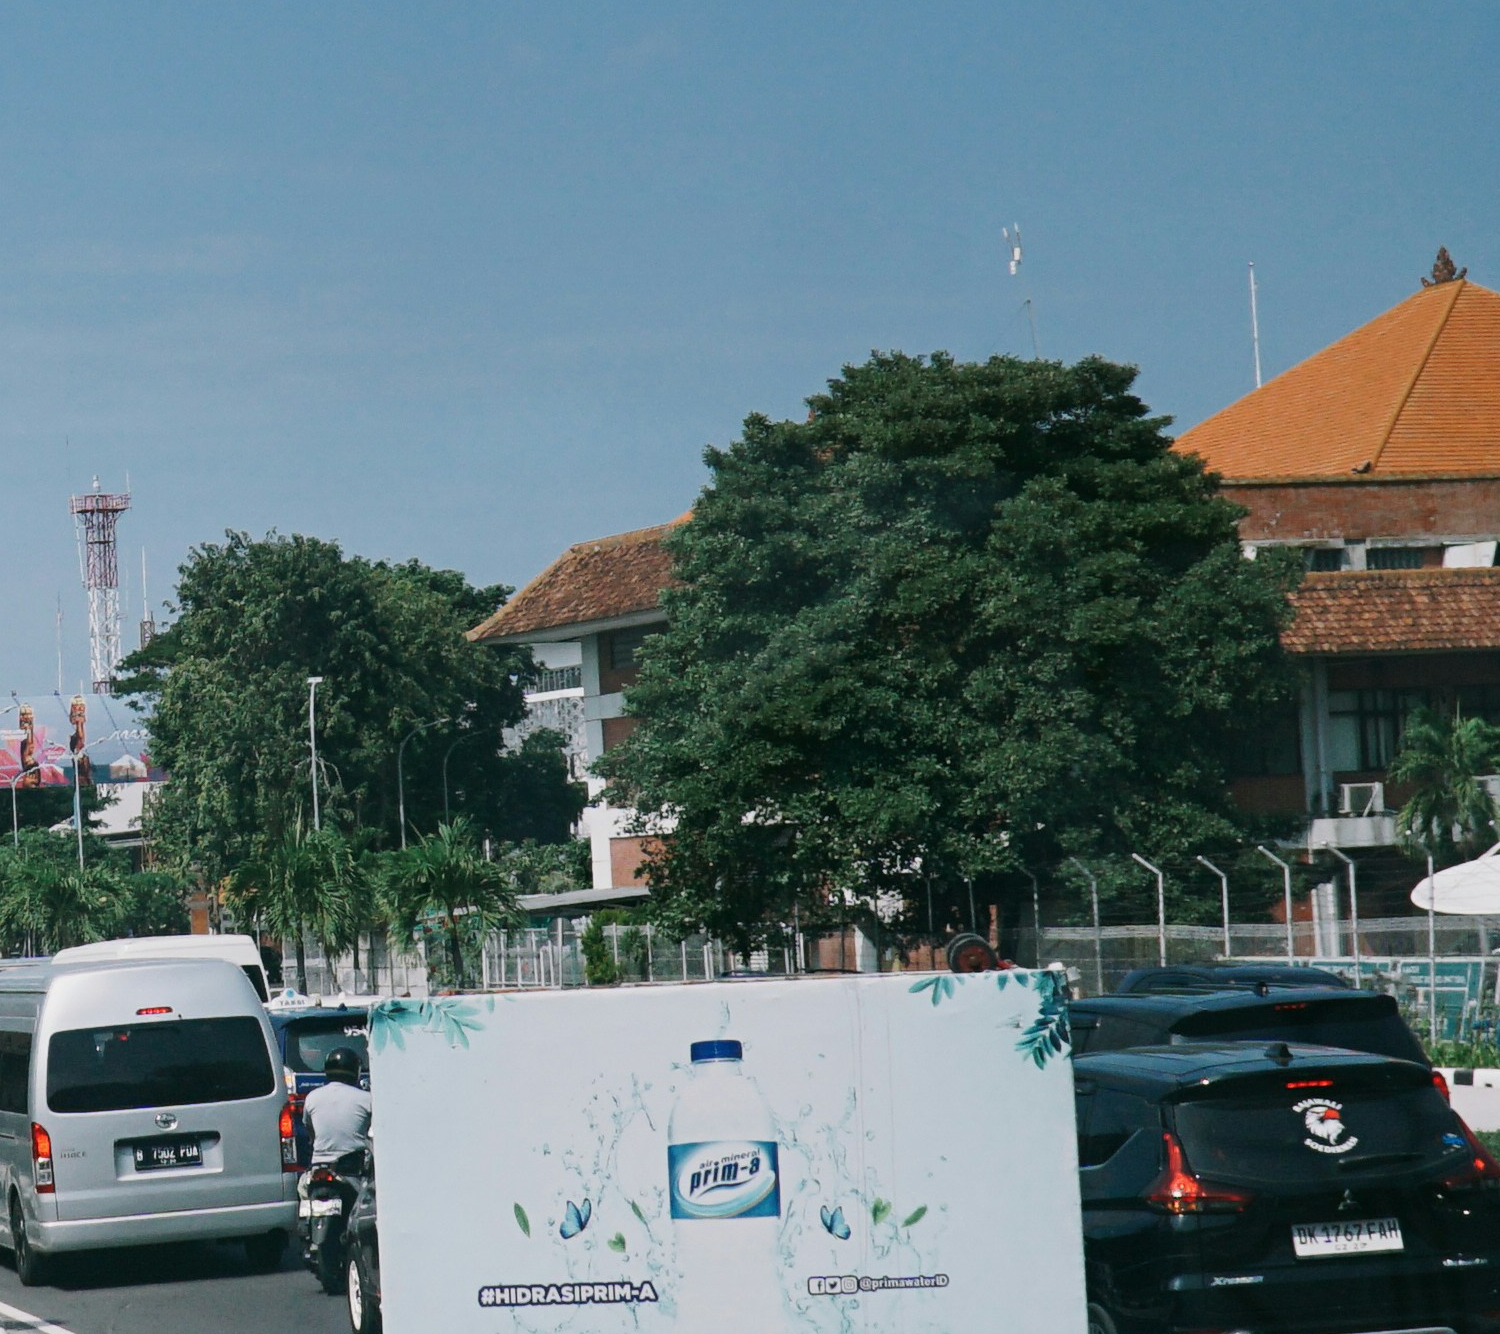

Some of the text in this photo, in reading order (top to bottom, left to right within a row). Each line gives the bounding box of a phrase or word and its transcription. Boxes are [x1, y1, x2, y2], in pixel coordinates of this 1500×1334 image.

[699, 1147, 761, 1170] air mineral
[689, 1156, 761, 1197] prim-a
[1297, 1219, 1399, 1245] DK 1767 FAH
[479, 1281, 658, 1306] #HIDRASIPRIM-A
